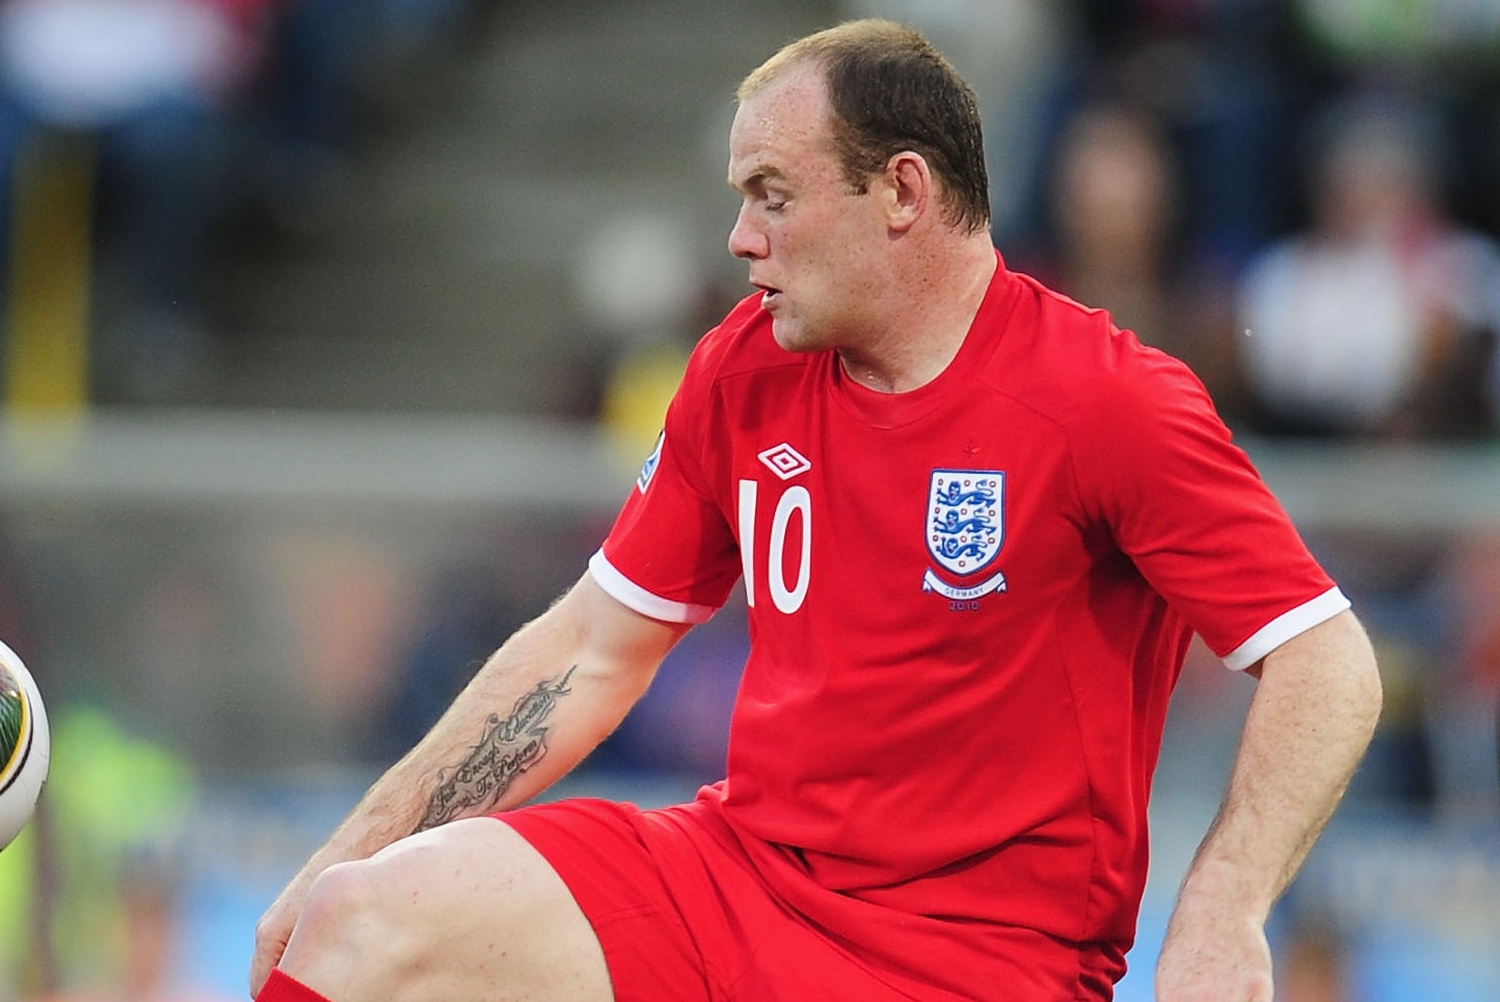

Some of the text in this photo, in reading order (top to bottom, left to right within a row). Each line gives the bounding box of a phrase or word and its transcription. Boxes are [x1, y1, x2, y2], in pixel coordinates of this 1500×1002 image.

[739, 480, 812, 614] 10
[944, 587, 985, 597] GERMANY
[949, 601, 980, 612] 2010
